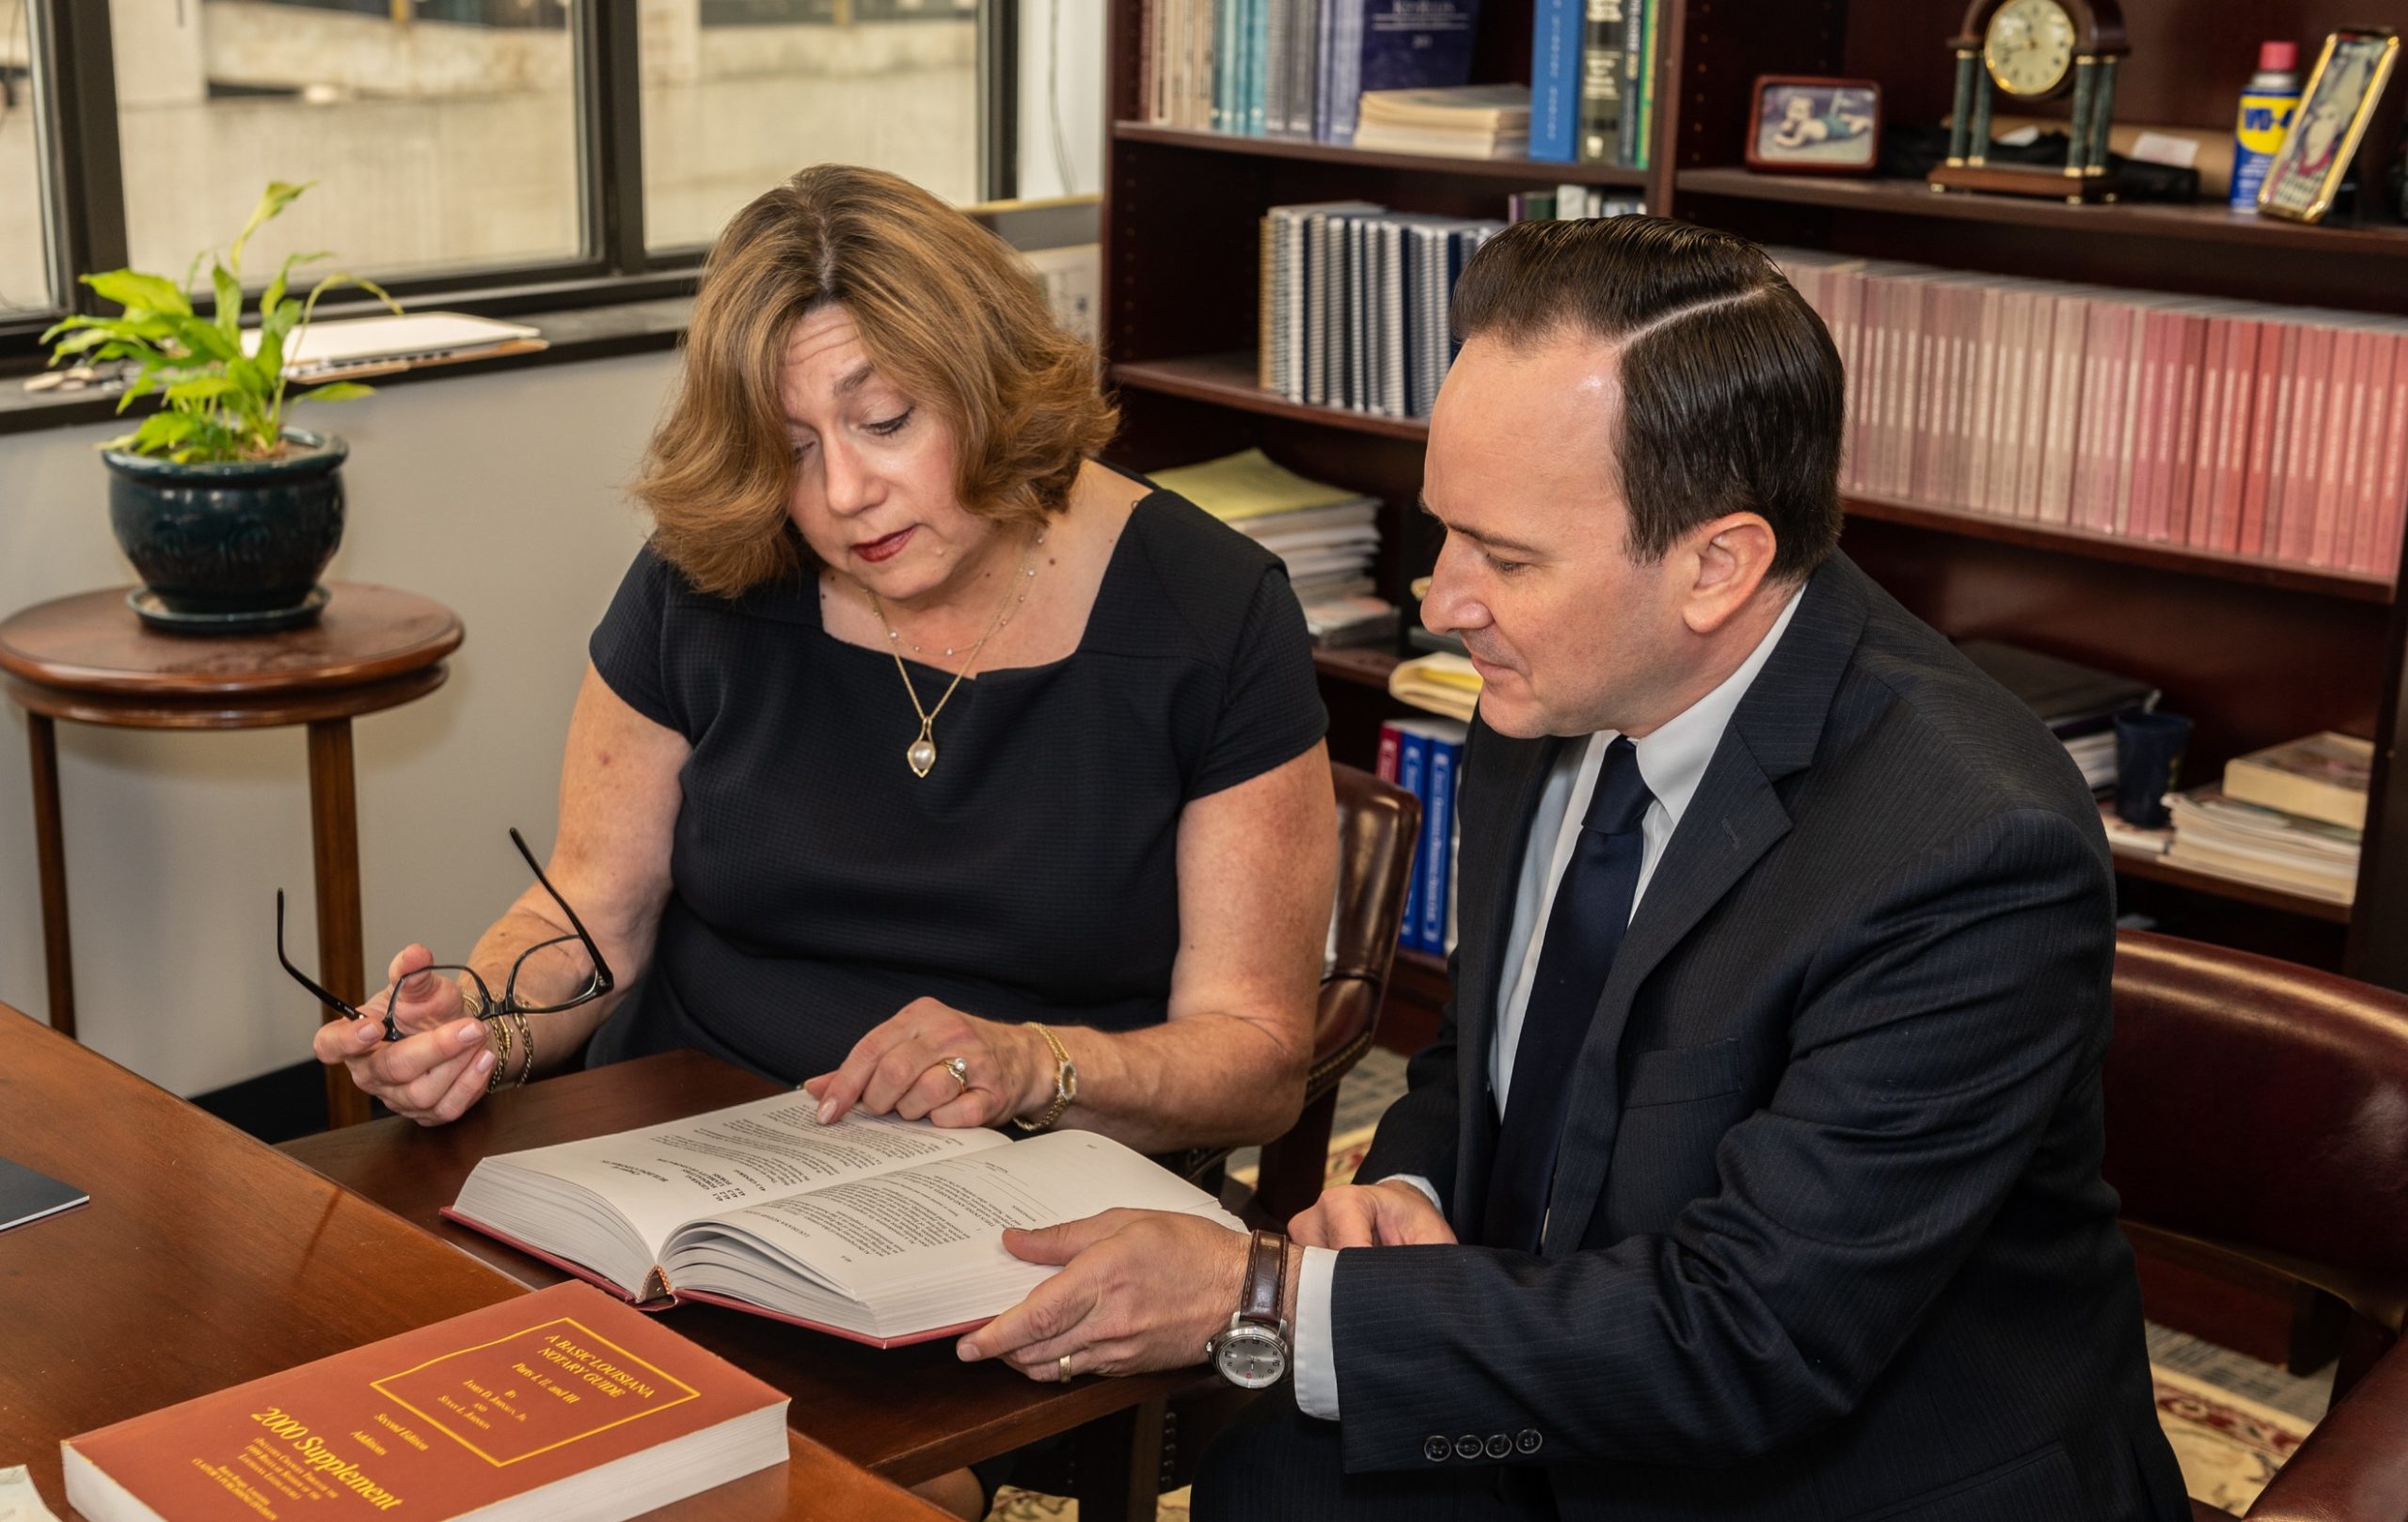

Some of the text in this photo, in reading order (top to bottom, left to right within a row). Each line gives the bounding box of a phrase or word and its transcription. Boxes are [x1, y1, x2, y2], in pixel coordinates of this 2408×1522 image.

[513, 1363, 534, 1377] Parts
[547, 1387, 569, 1396] and
[563, 1394, 579, 1403] III
[538, 1348, 626, 1397] NOTARY GUIDE
[556, 1340, 595, 1360] BASIC
[589, 1359, 654, 1398] LOUISIANA
[351, 1431, 386, 1455] Additions
[374, 1414, 428, 1451] Second Edition
[251, 1407, 403, 1510] 2000 Supplement
